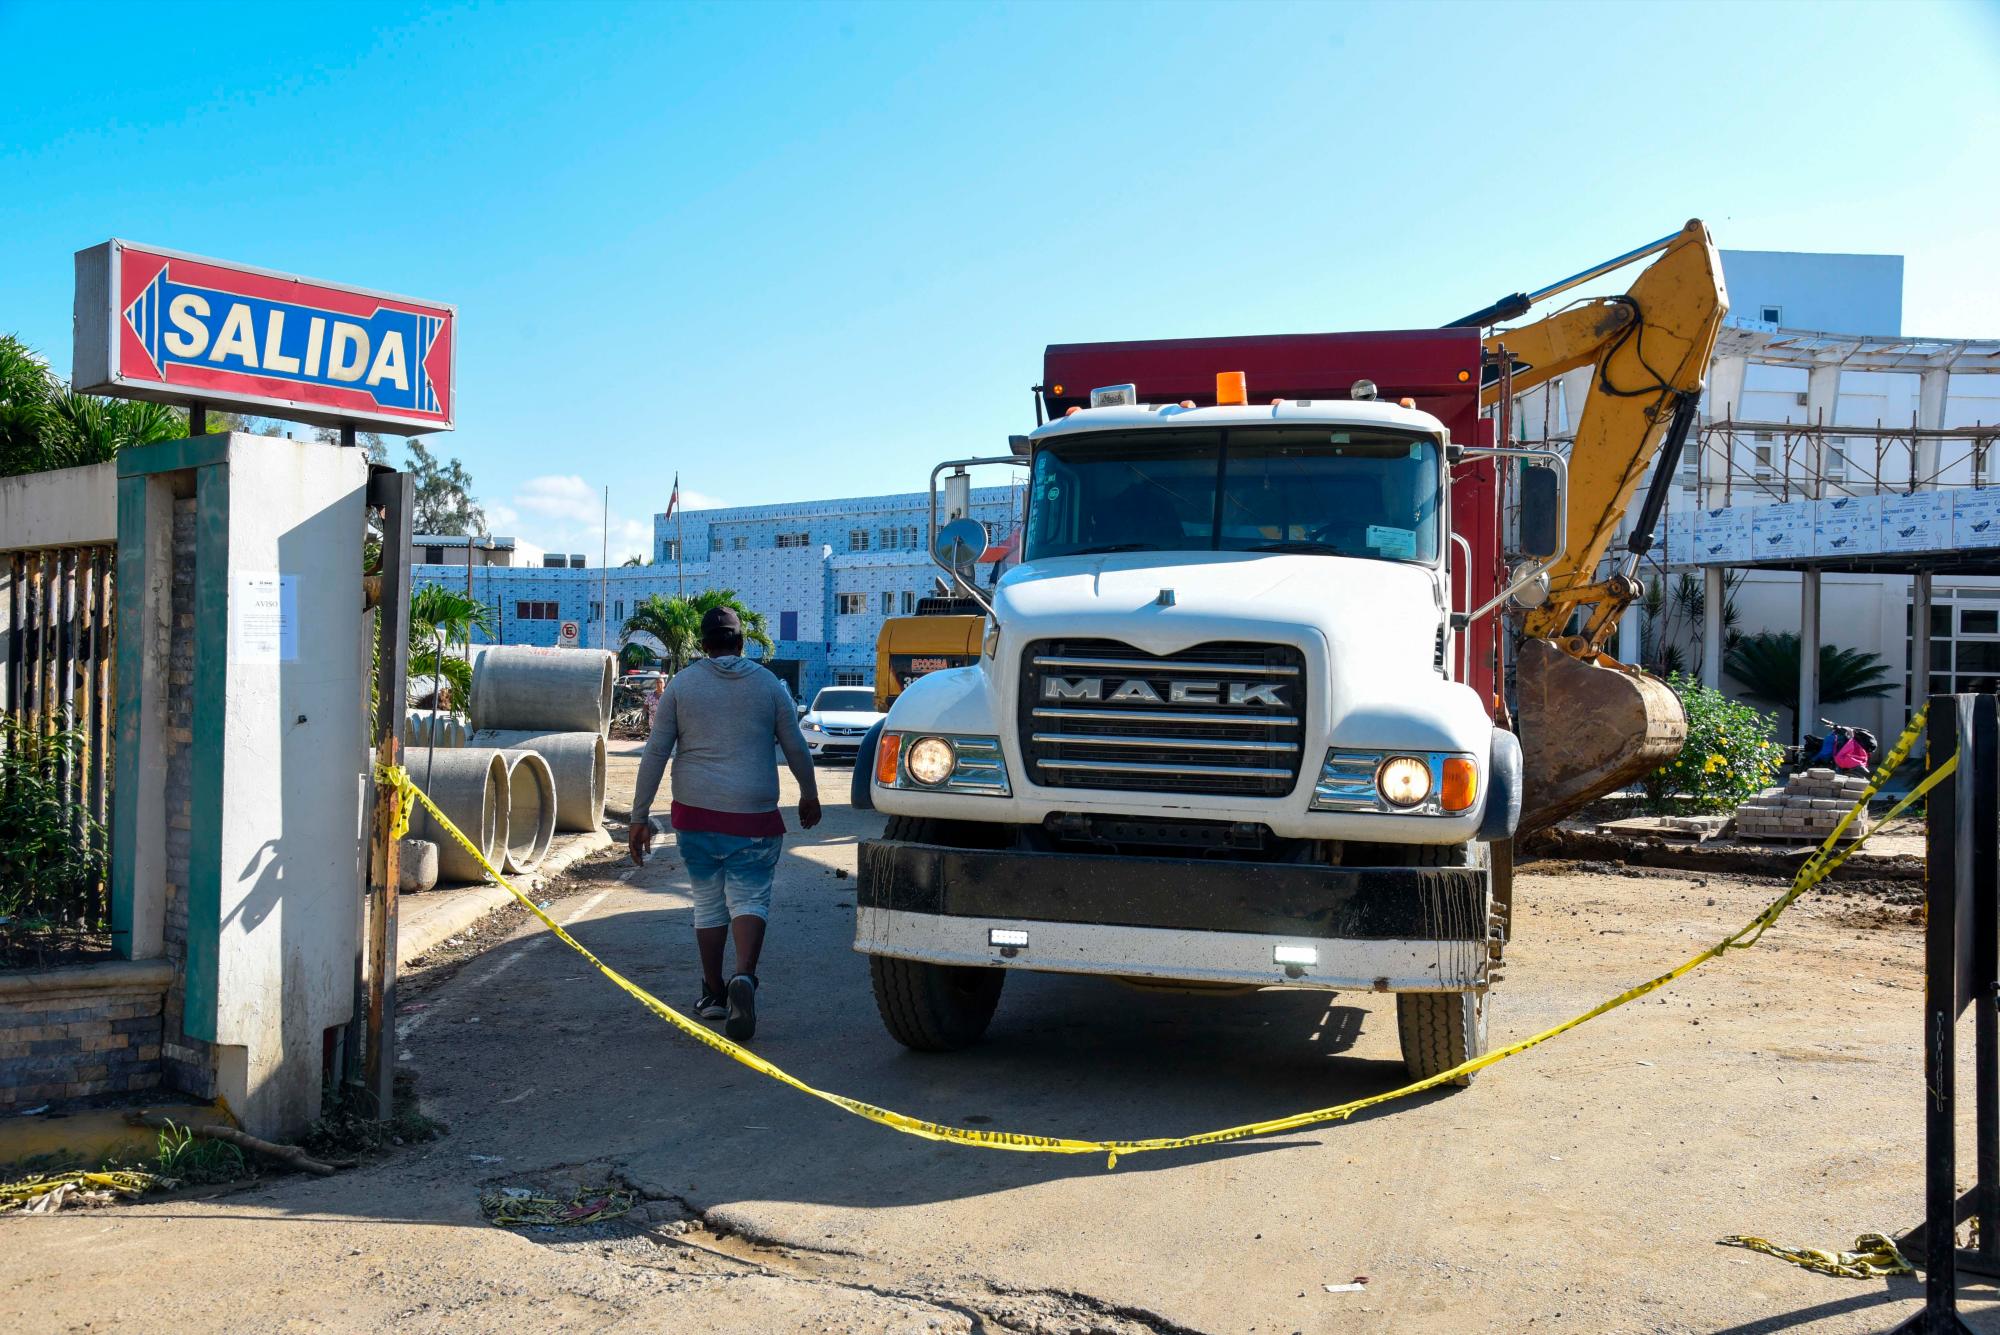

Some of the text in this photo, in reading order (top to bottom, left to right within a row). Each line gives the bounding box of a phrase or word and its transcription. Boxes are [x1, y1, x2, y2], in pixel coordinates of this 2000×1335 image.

[164, 293, 409, 391] SALIDA
[255, 600, 278, 608] AVISO
[1044, 676, 1288, 706] MACK
